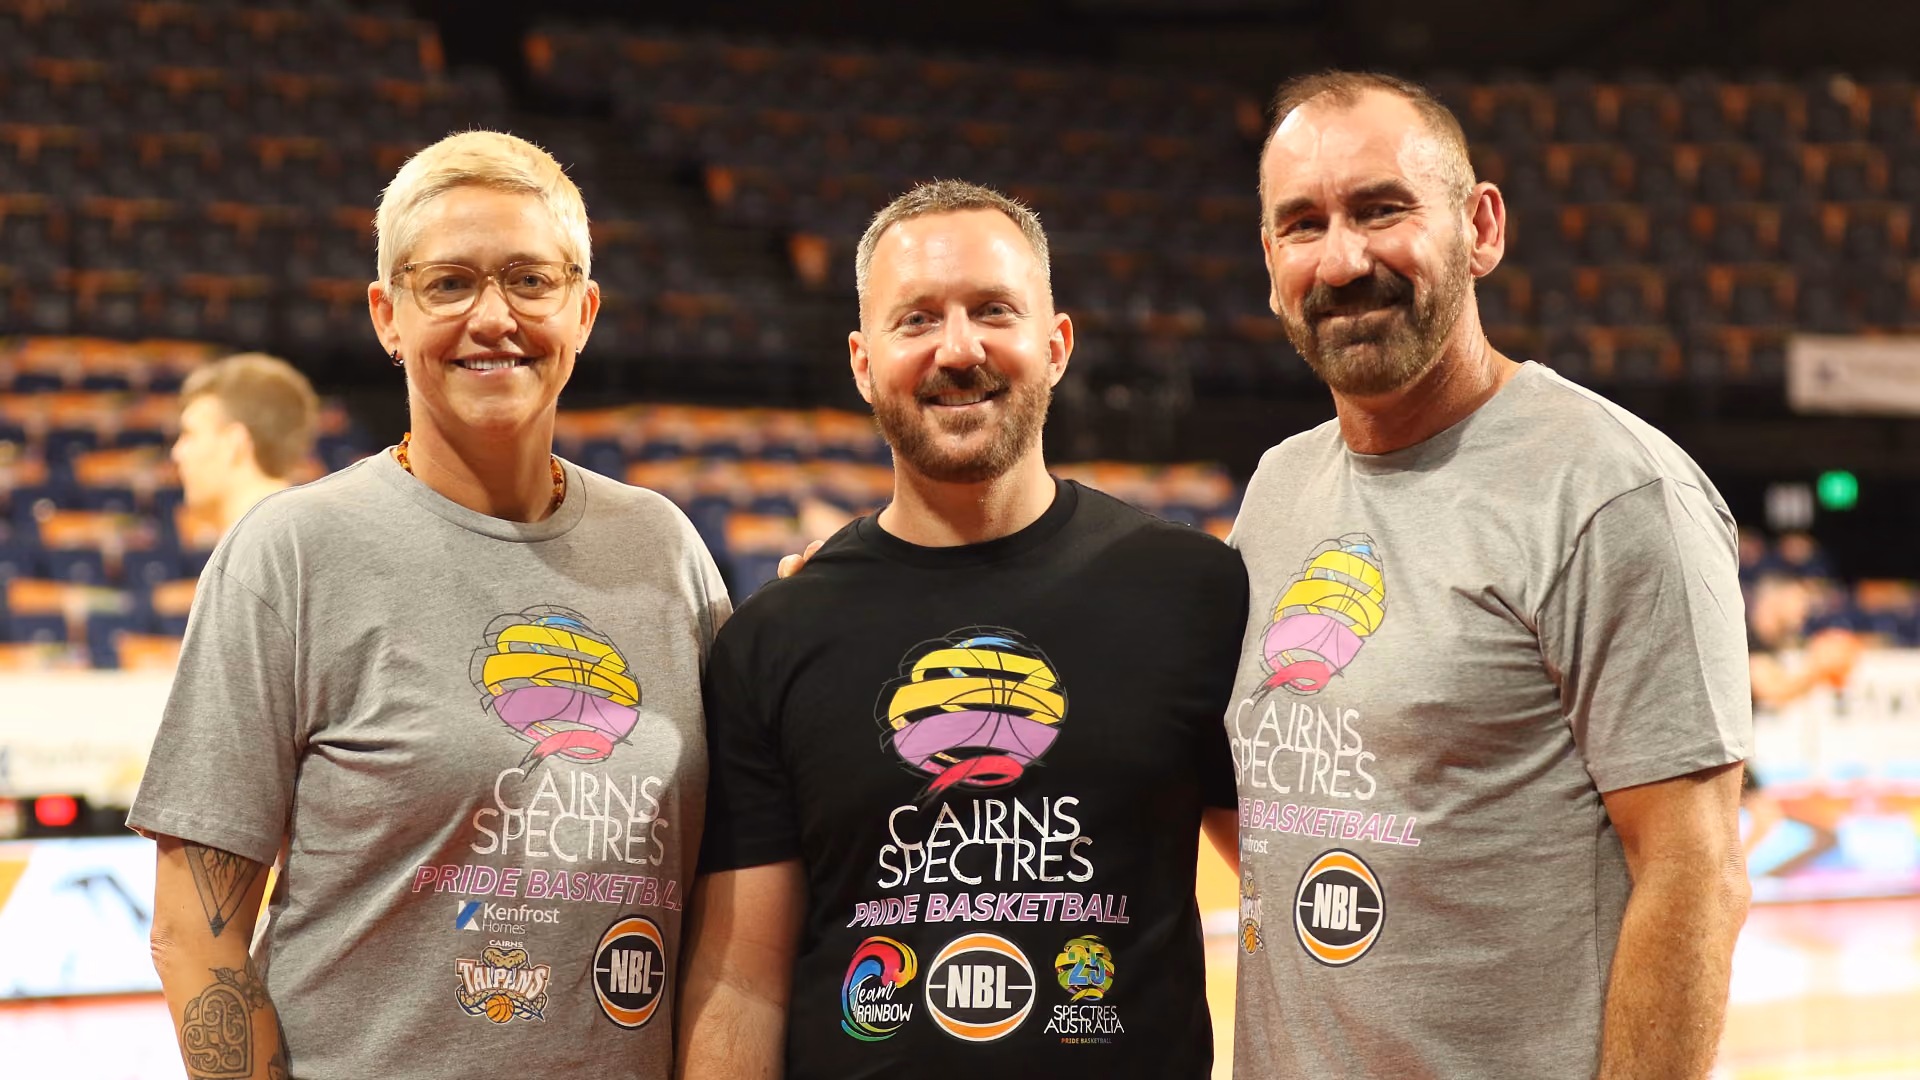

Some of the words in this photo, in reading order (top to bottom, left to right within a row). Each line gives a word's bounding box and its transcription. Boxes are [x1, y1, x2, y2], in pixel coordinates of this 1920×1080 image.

[1235, 699, 1362, 756] CAIRNS
[1231, 738, 1376, 800] SPECTRES
[494, 768, 662, 823] CAIRNS
[471, 808, 668, 866] SPECTRES
[889, 796, 1081, 850] CAIRNS
[1251, 799, 1420, 846] BASKETBALL
[412, 865, 521, 897] PRIDE
[878, 836, 1094, 889] SPECTRES
[482, 919, 526, 935] Homes
[483, 902, 560, 924] Kenfrost
[846, 894, 920, 928] PRIDE
[924, 892, 1130, 924] BASKETBALL
[1312, 882, 1361, 931] NBL
[489, 939, 524, 948] CAIRNS
[1066, 943, 1106, 986] 25
[455, 958, 551, 1001] TAIPANS
[610, 949, 653, 994] NBL
[849, 974, 897, 1011] Team
[946, 964, 1012, 1008] NBL
[856, 1003, 913, 1023] RAINBOW
[1043, 1018, 1125, 1034] AUSTRALIA
[1053, 1005, 1117, 1021] SPECTRES
